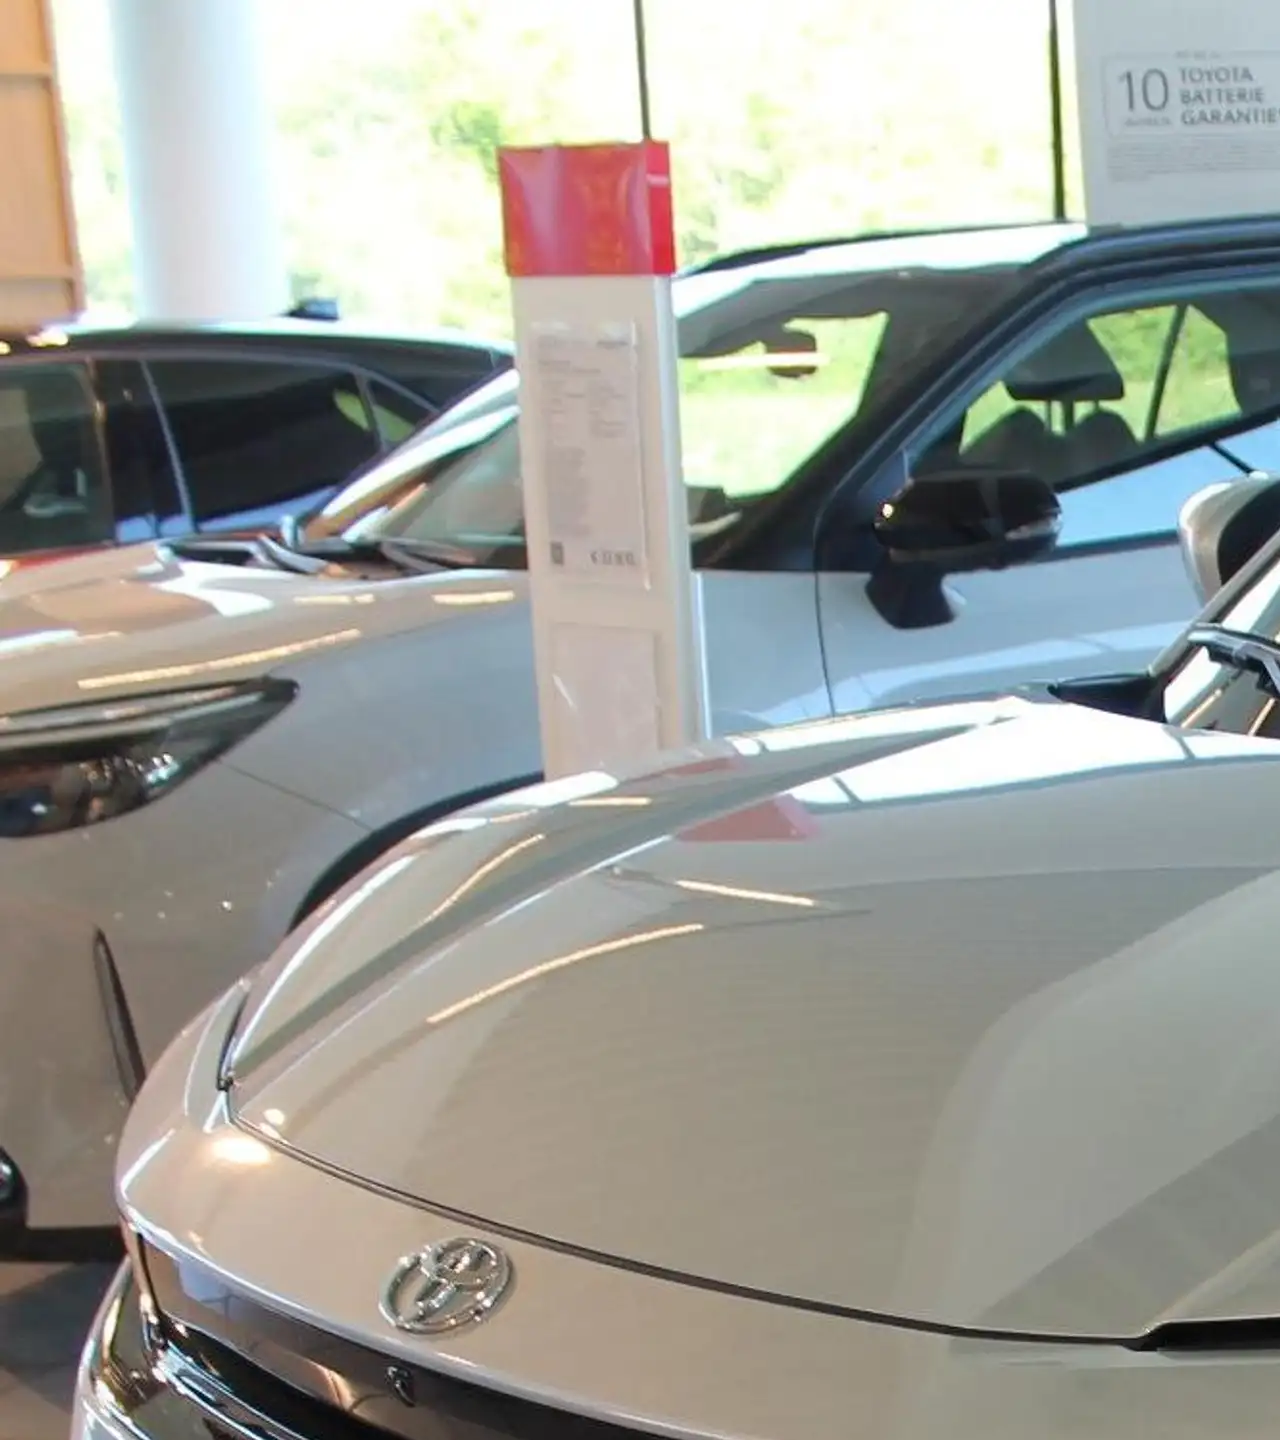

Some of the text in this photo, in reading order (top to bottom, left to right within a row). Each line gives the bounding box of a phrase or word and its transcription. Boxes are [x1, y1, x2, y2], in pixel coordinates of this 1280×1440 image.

[1180, 67, 1254, 82] TOYOTA
[1119, 68, 1169, 111] 10
[1180, 88, 1265, 104] BATTERIE
